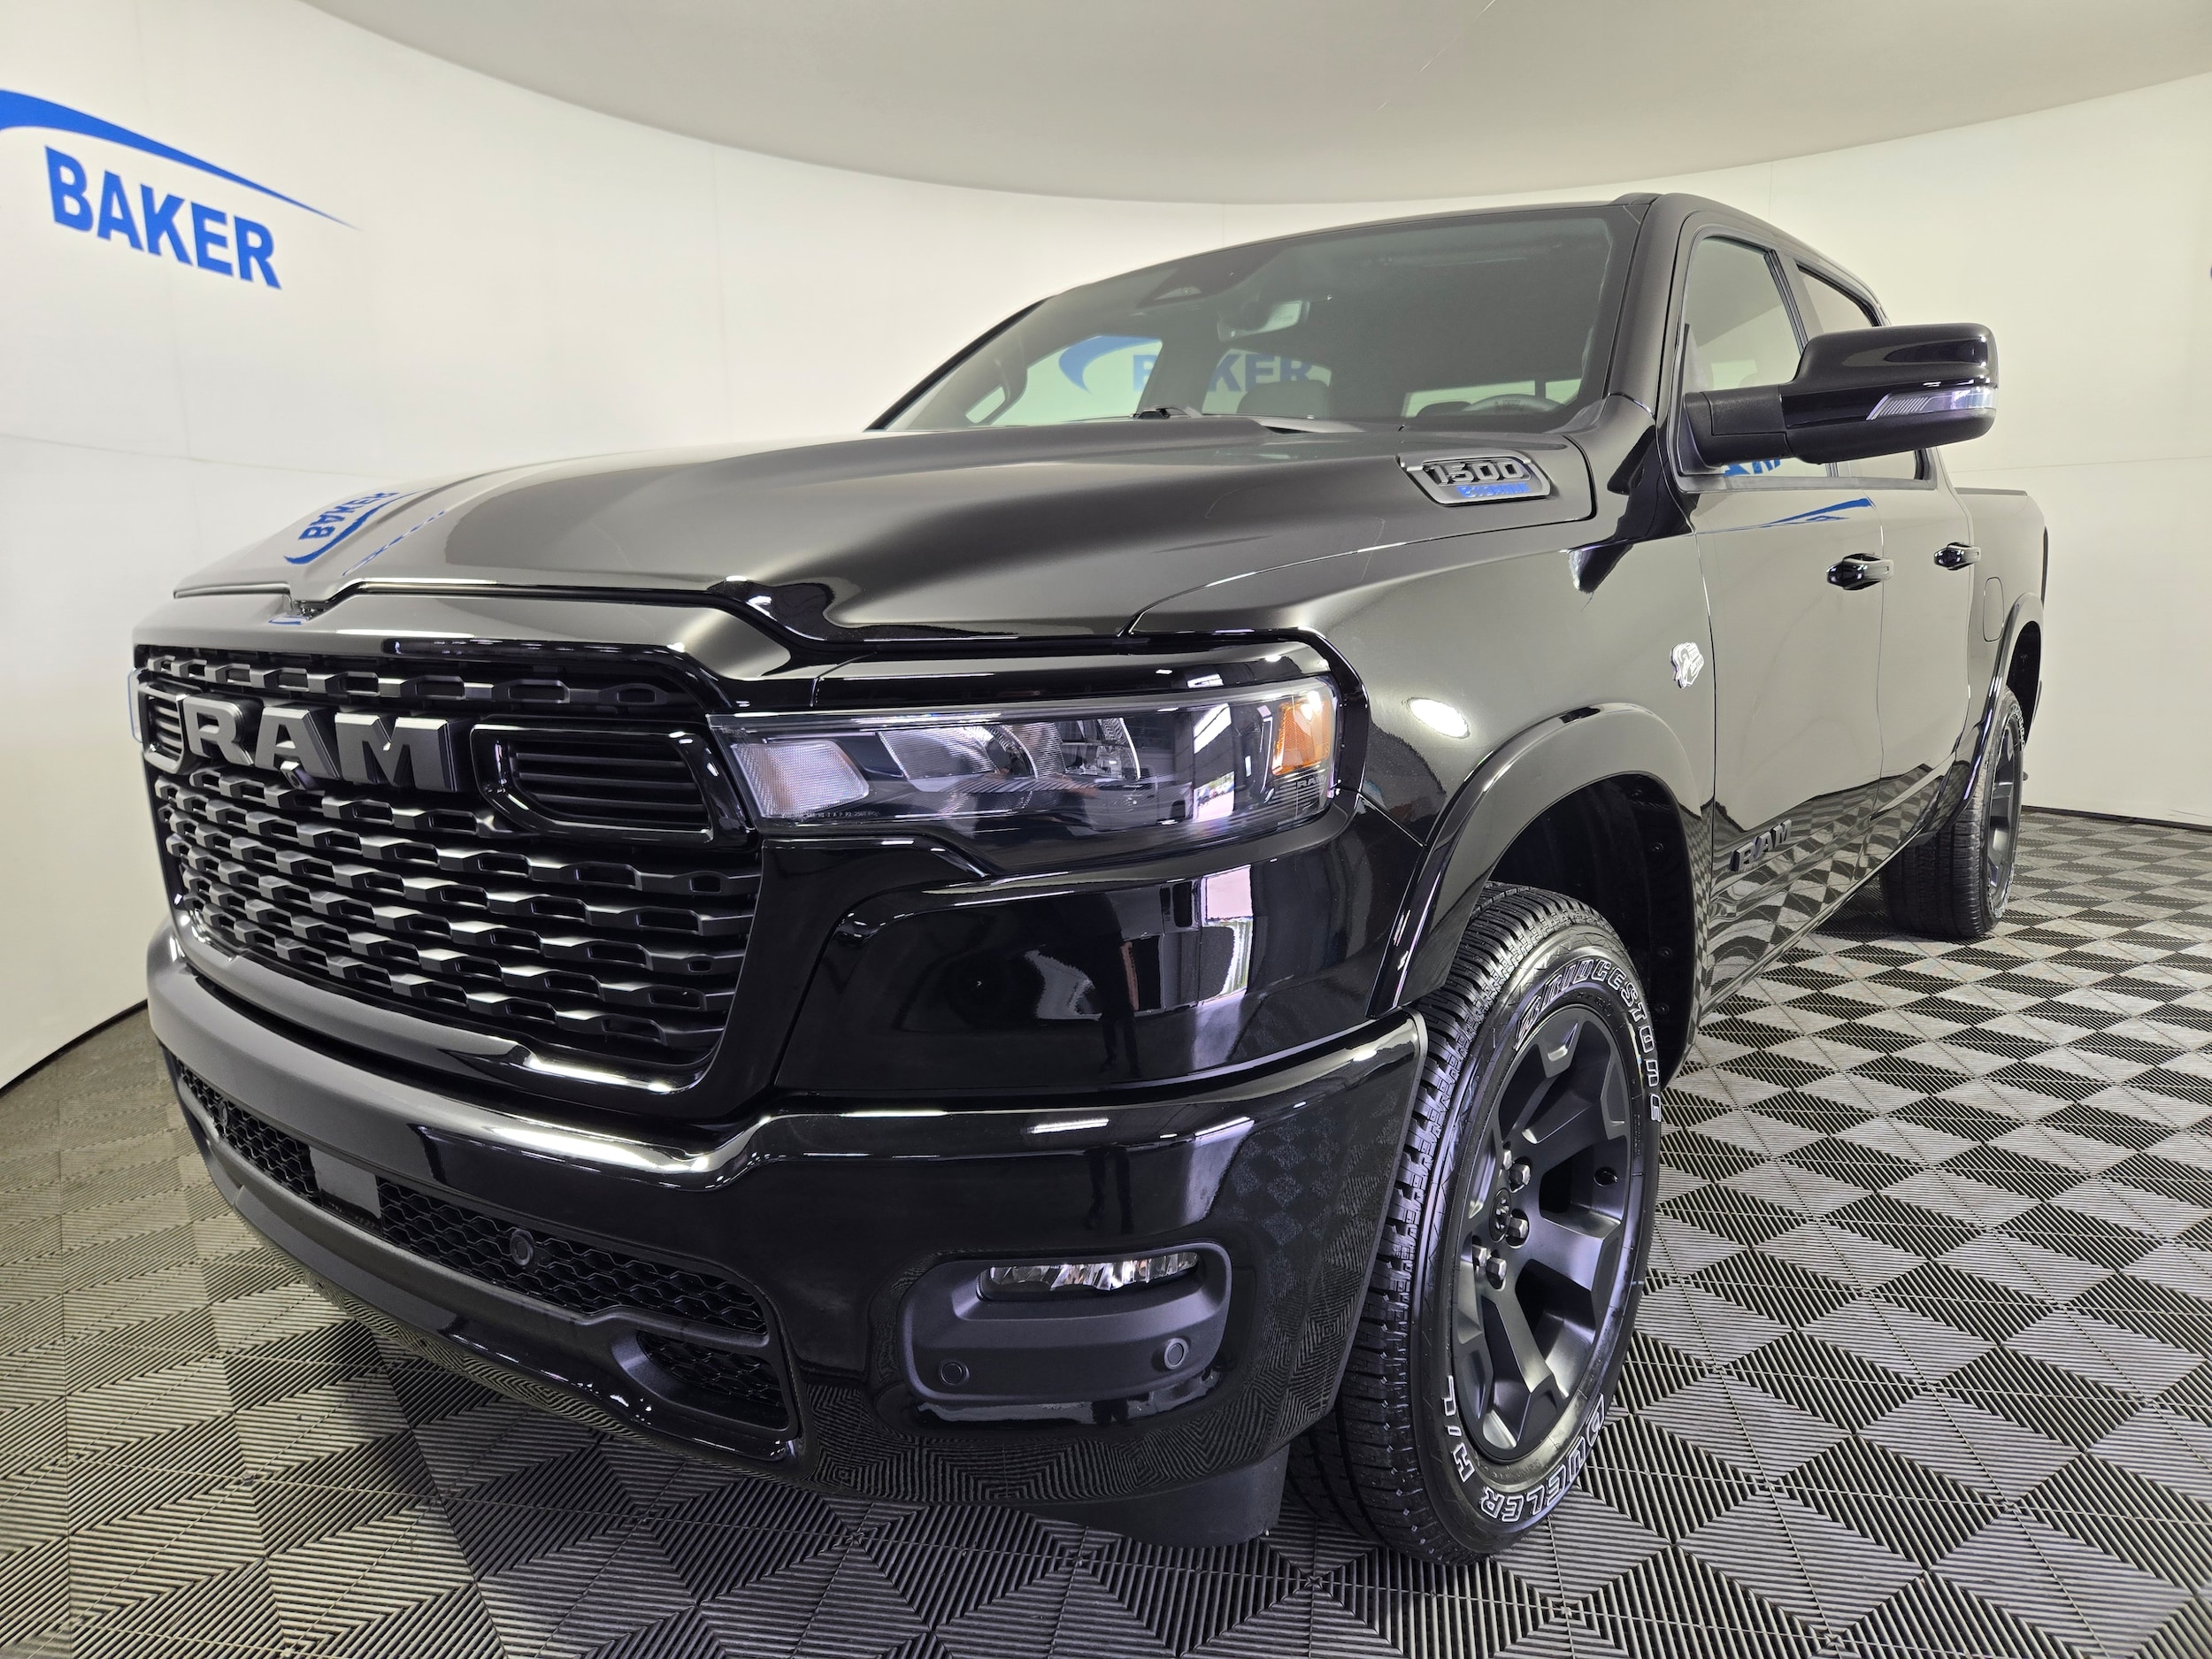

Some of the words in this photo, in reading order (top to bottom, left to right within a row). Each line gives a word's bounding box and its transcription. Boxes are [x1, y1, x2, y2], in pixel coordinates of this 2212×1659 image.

[45, 145, 281, 290] BAKER
[1133, 355, 1314, 392] BKER
[1425, 461, 1531, 487] 1500
[181, 693, 457, 793] RAM
[1729, 818, 1792, 872] RAM
[1513, 958, 1662, 1123] BRIDGESTONE
[1479, 1393, 1606, 1523] DUELER
